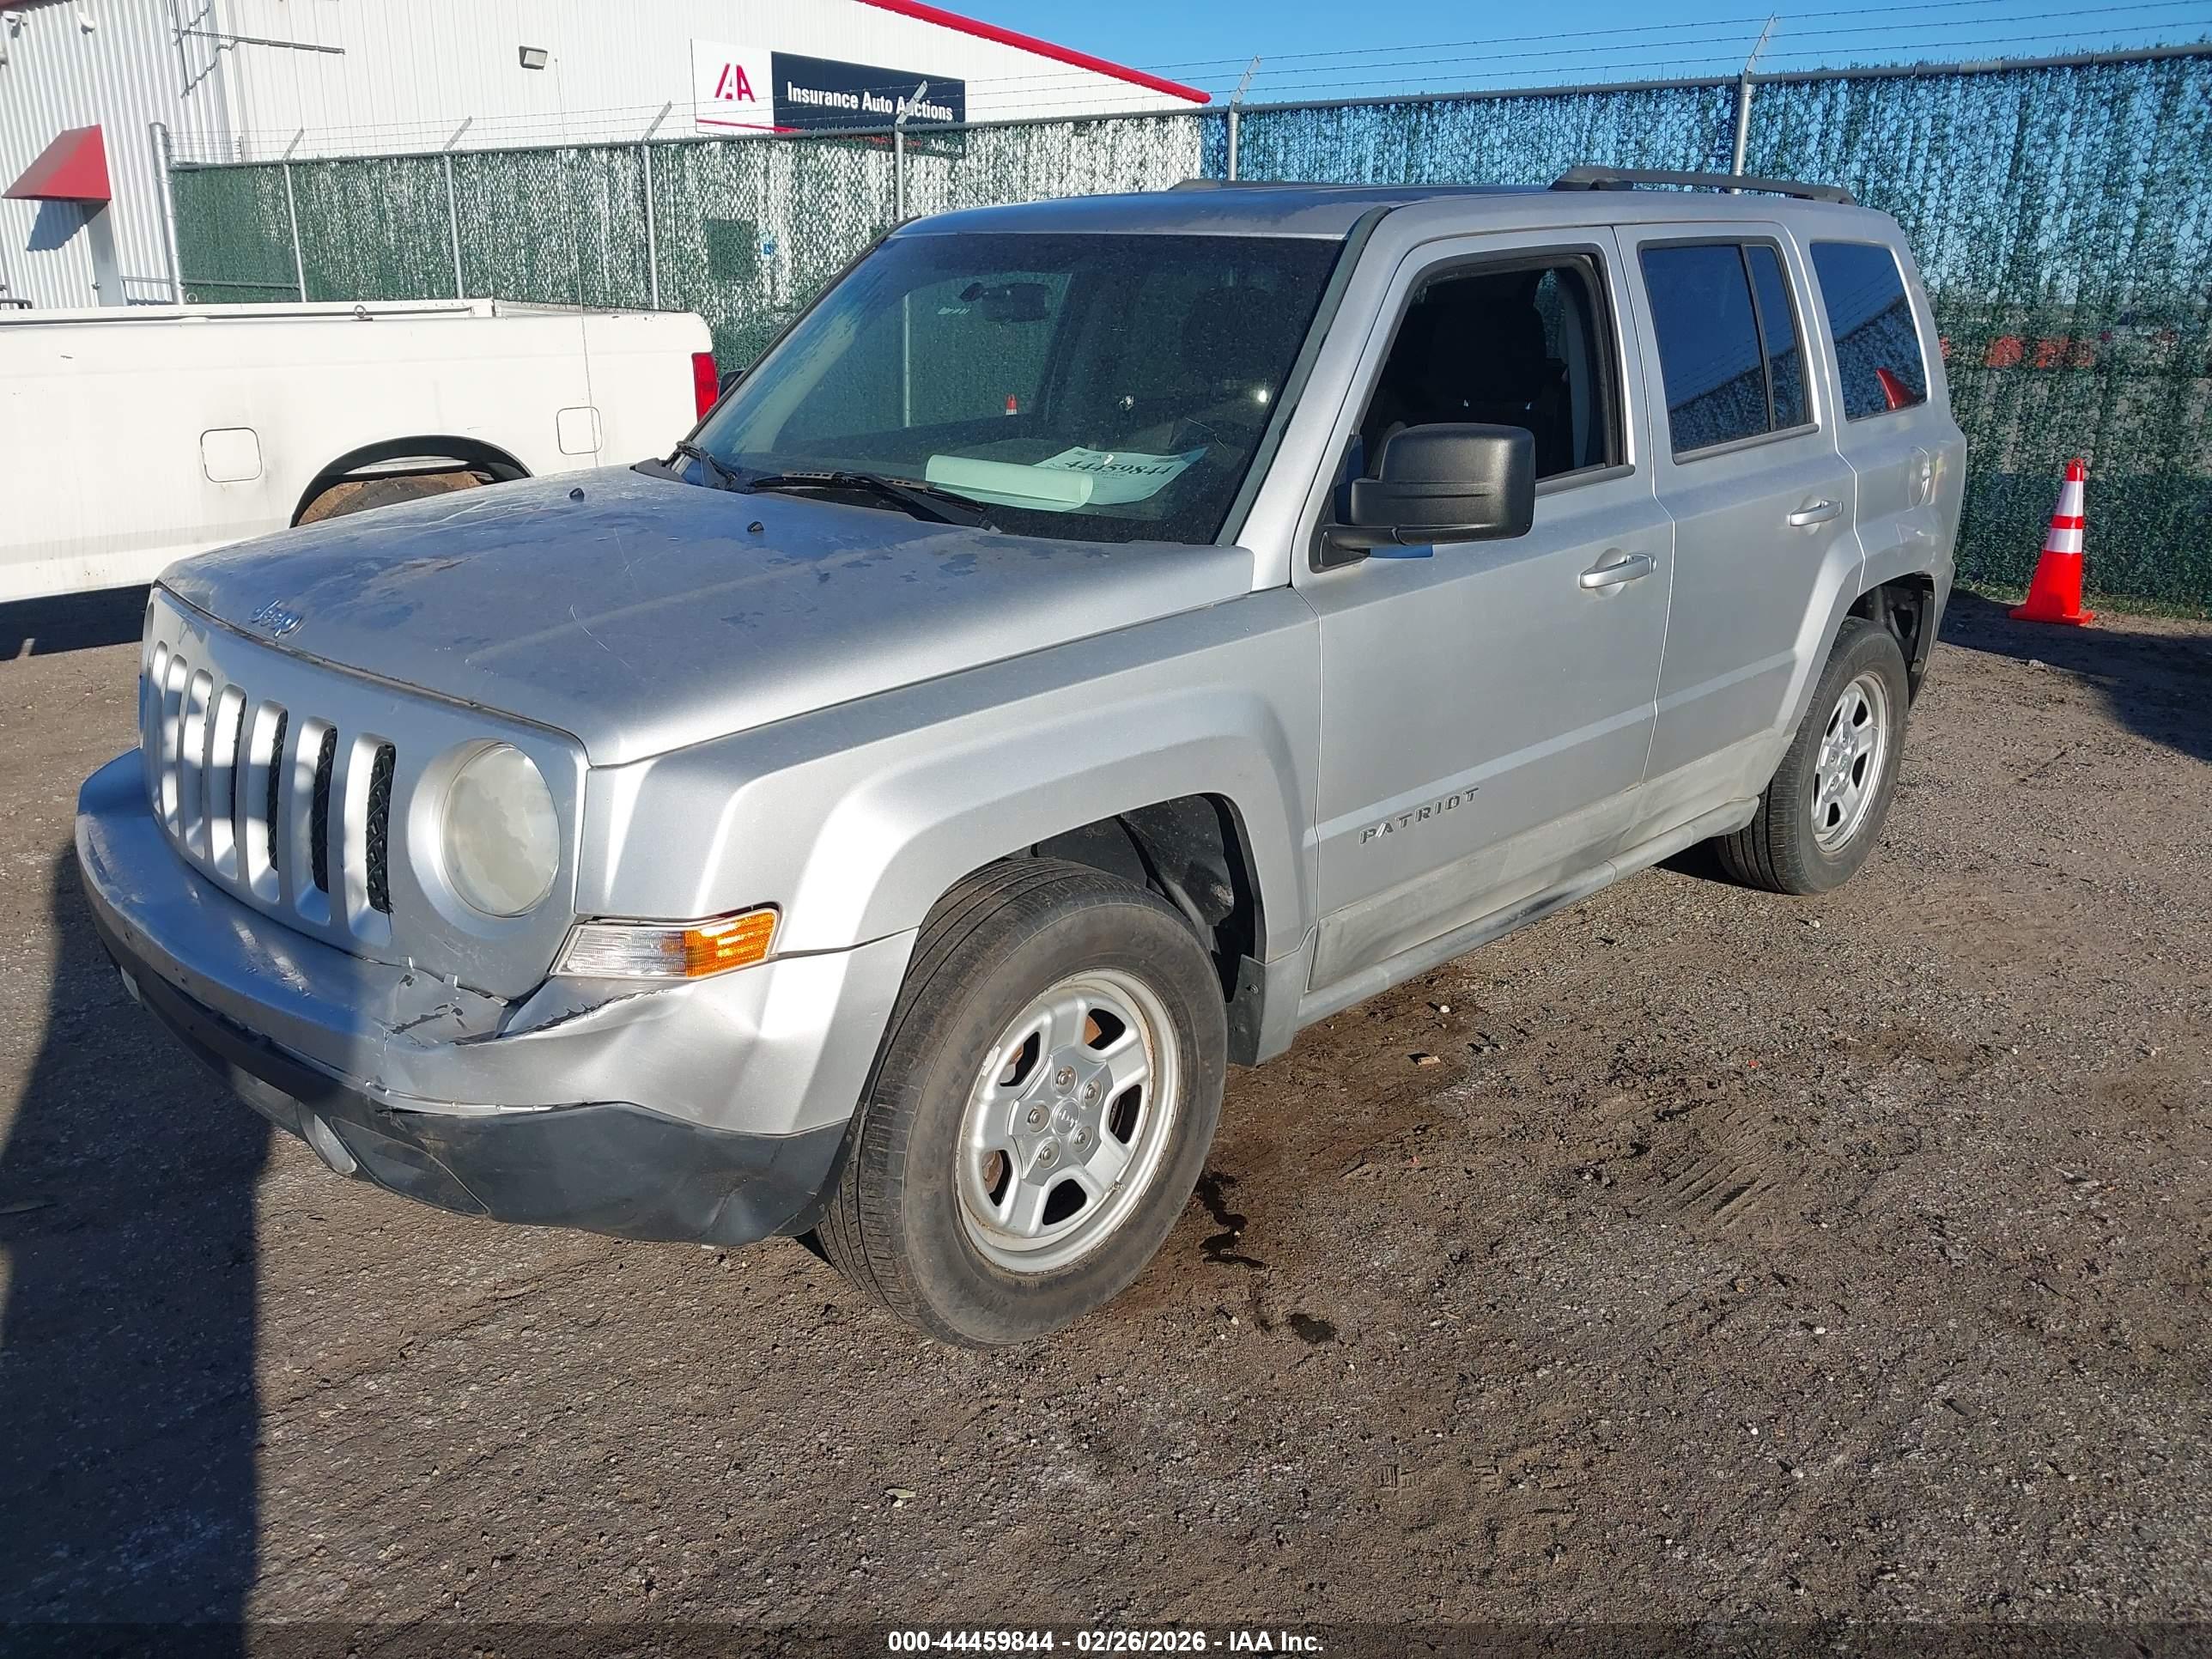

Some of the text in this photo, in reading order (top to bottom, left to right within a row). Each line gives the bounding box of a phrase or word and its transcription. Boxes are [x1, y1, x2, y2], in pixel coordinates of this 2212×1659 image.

[787, 81, 953, 121] Insurance Auto Actions
[247, 599, 302, 638] Jeep
[1358, 787, 1480, 845] PATRIOT
